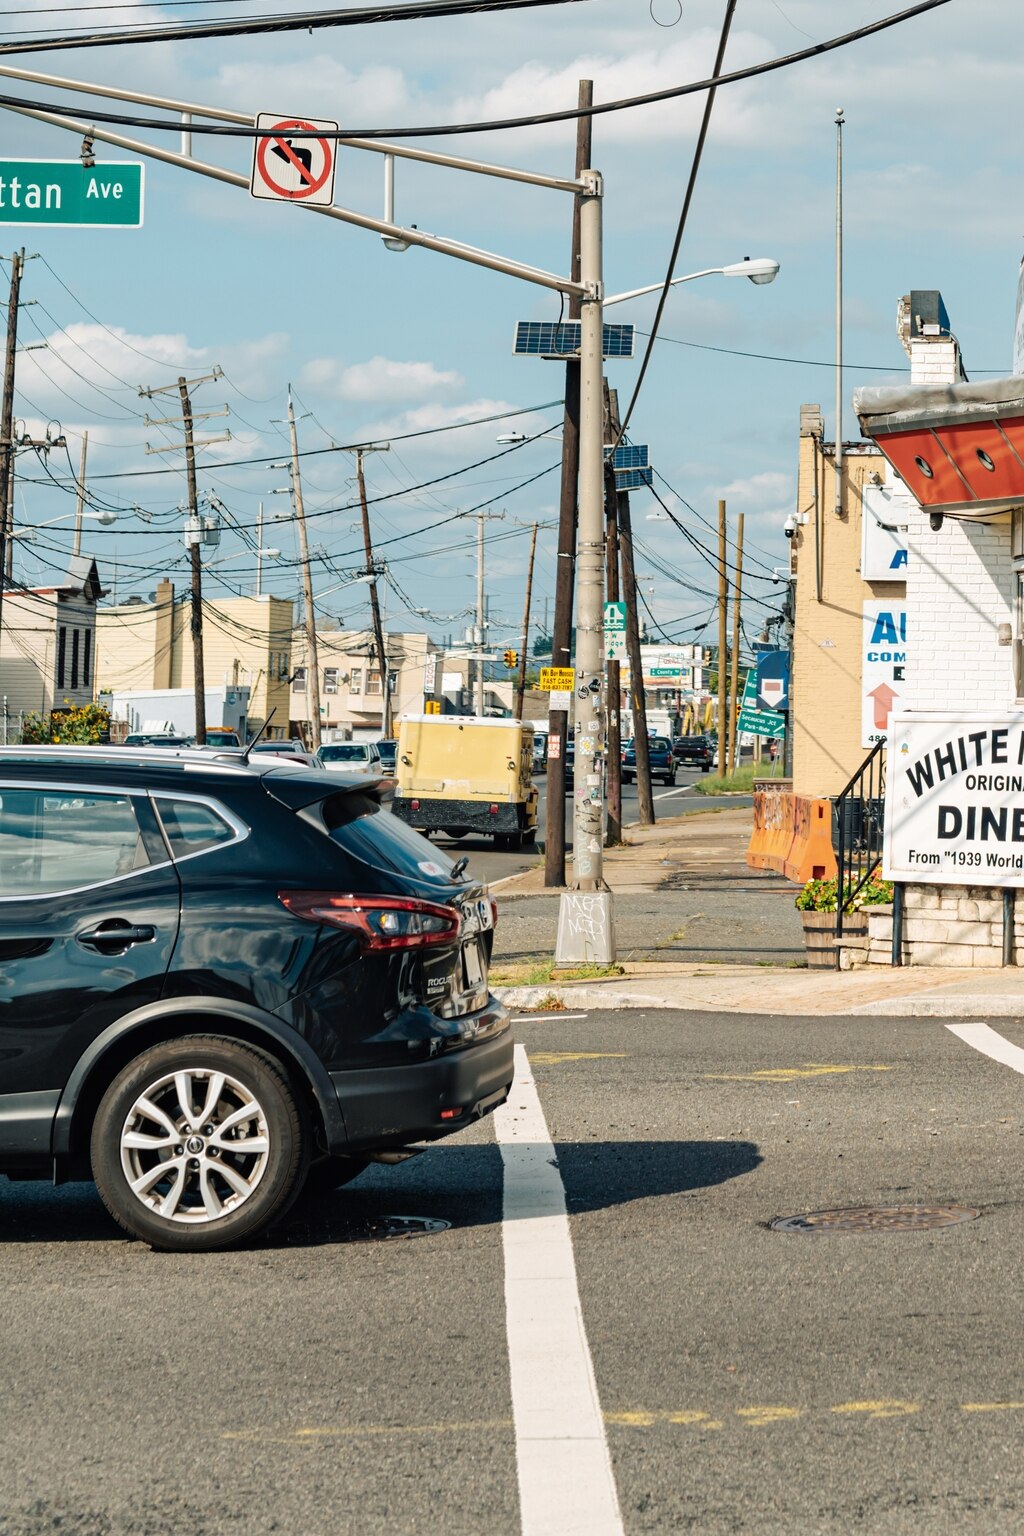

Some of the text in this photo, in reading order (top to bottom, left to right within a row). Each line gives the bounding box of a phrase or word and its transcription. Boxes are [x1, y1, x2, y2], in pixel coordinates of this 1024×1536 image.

[86, 177, 124, 199] Ave
[741, 714, 766, 724] Secaucus
[905, 729, 1009, 797] WHITE
[908, 849, 941, 865] From
[944, 850, 982, 867] "1939
